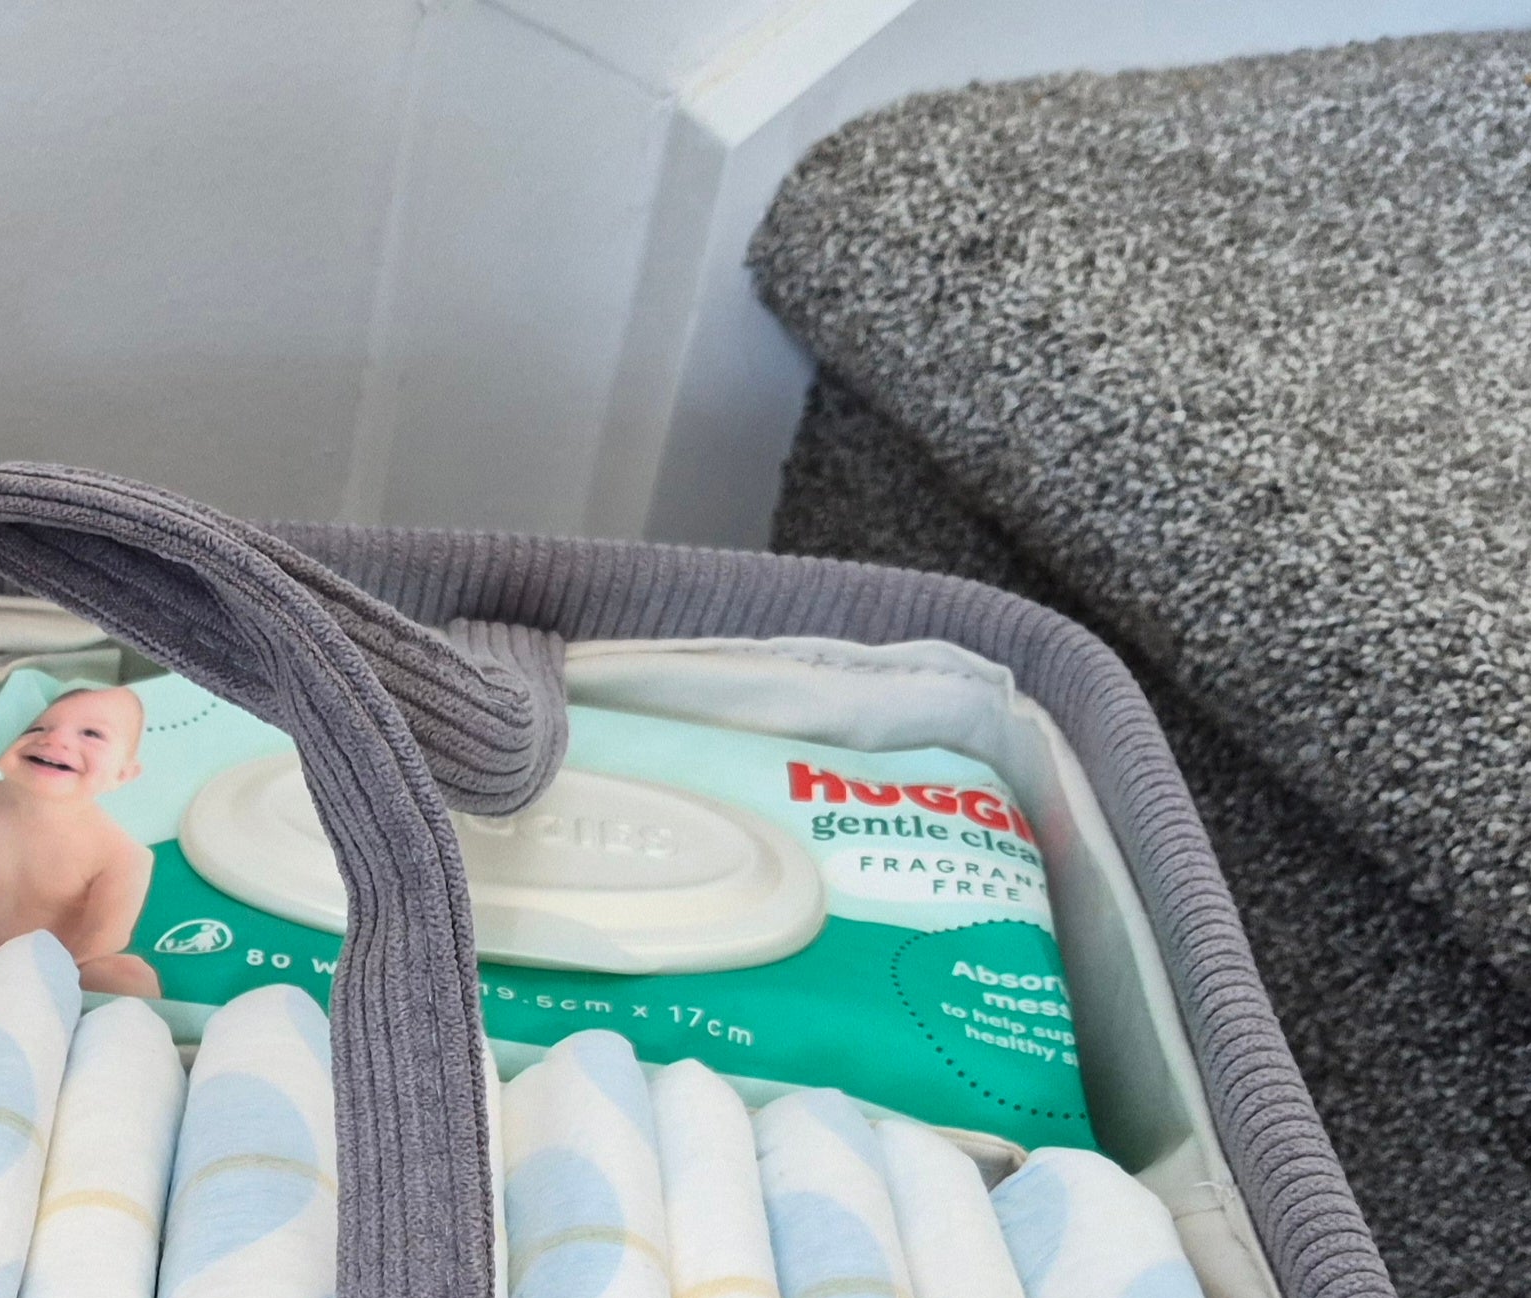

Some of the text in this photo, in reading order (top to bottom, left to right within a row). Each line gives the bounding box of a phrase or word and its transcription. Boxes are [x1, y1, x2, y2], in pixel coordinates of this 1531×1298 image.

[812, 811, 949, 841] gentle
[932, 879, 1021, 902] FREE
[246, 948, 291, 969] 80
[632, 1004, 649, 1018] x
[668, 1005, 755, 1047] 17cm
[940, 1002, 968, 1019] to
[972, 1008, 1027, 1035] help
[965, 1024, 1057, 1062] healthy
